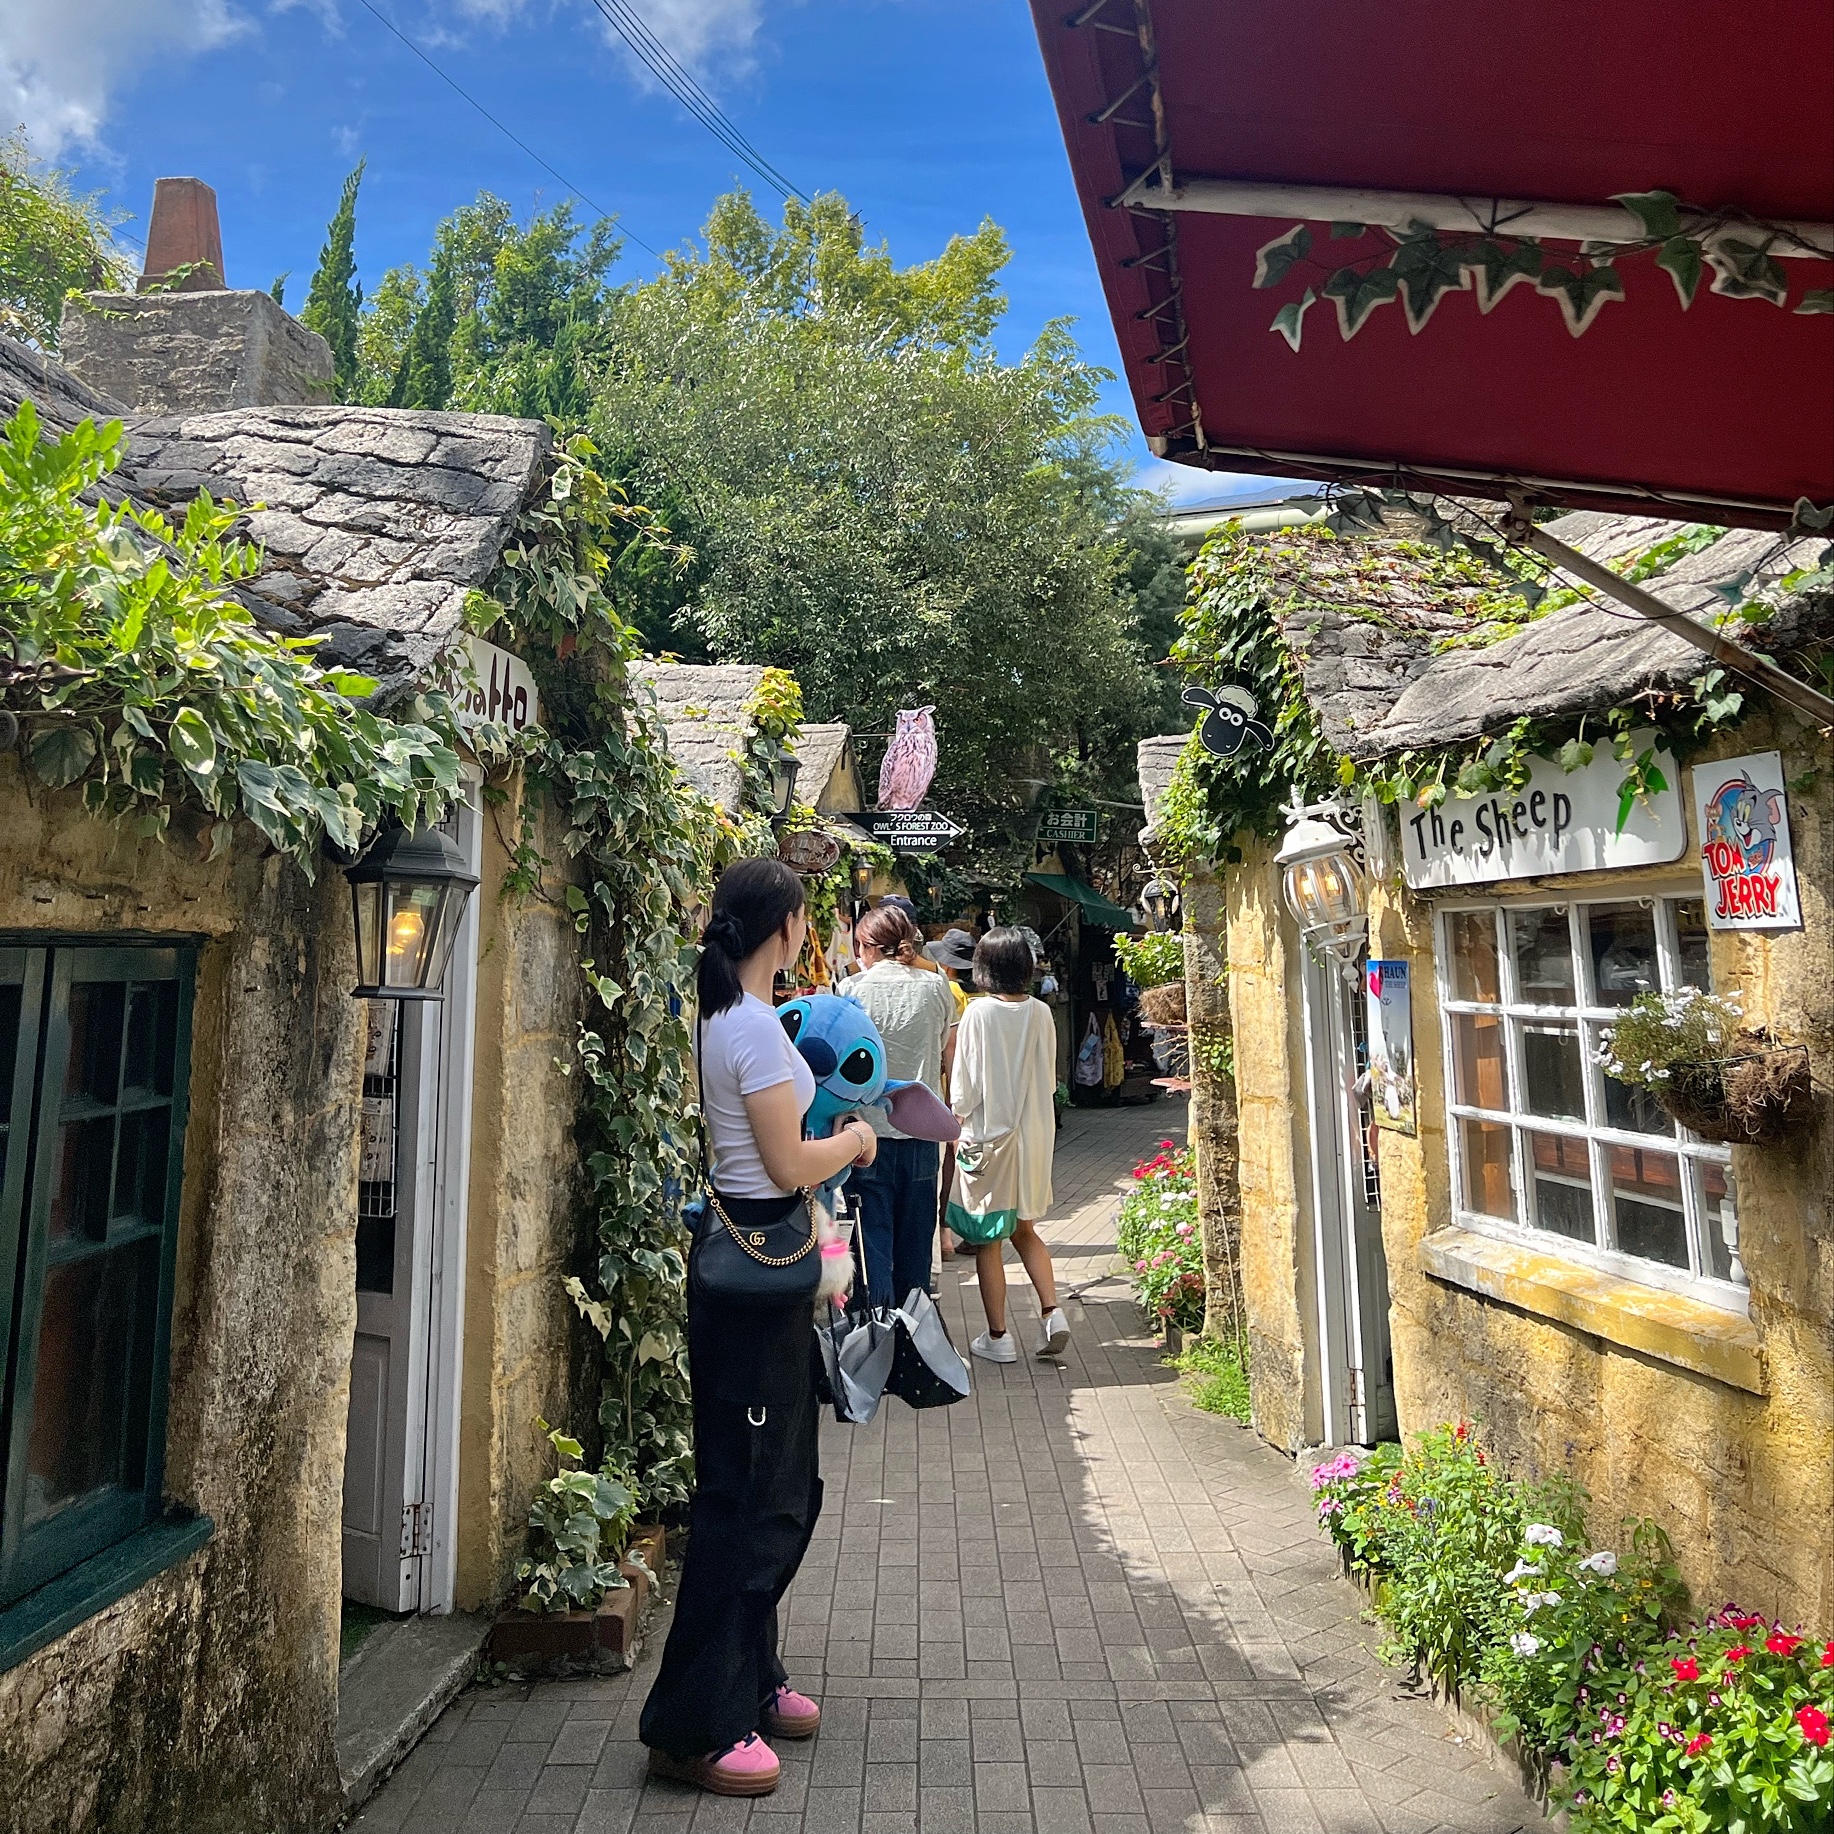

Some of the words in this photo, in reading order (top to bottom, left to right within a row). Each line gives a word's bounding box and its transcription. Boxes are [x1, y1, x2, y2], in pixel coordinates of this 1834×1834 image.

[901, 822, 930, 831] FOREST
[930, 821, 948, 830] ZOO
[1047, 812, 1088, 828] お会計
[1410, 804, 1463, 859] The
[1476, 790, 1571, 858] Sheep
[890, 834, 938, 847] Entrance
[1046, 829, 1086, 840] CASHIER
[1702, 839, 1746, 881] TOM
[1715, 873, 1782, 919] JERRY
[1378, 965, 1407, 985] SHAUN
